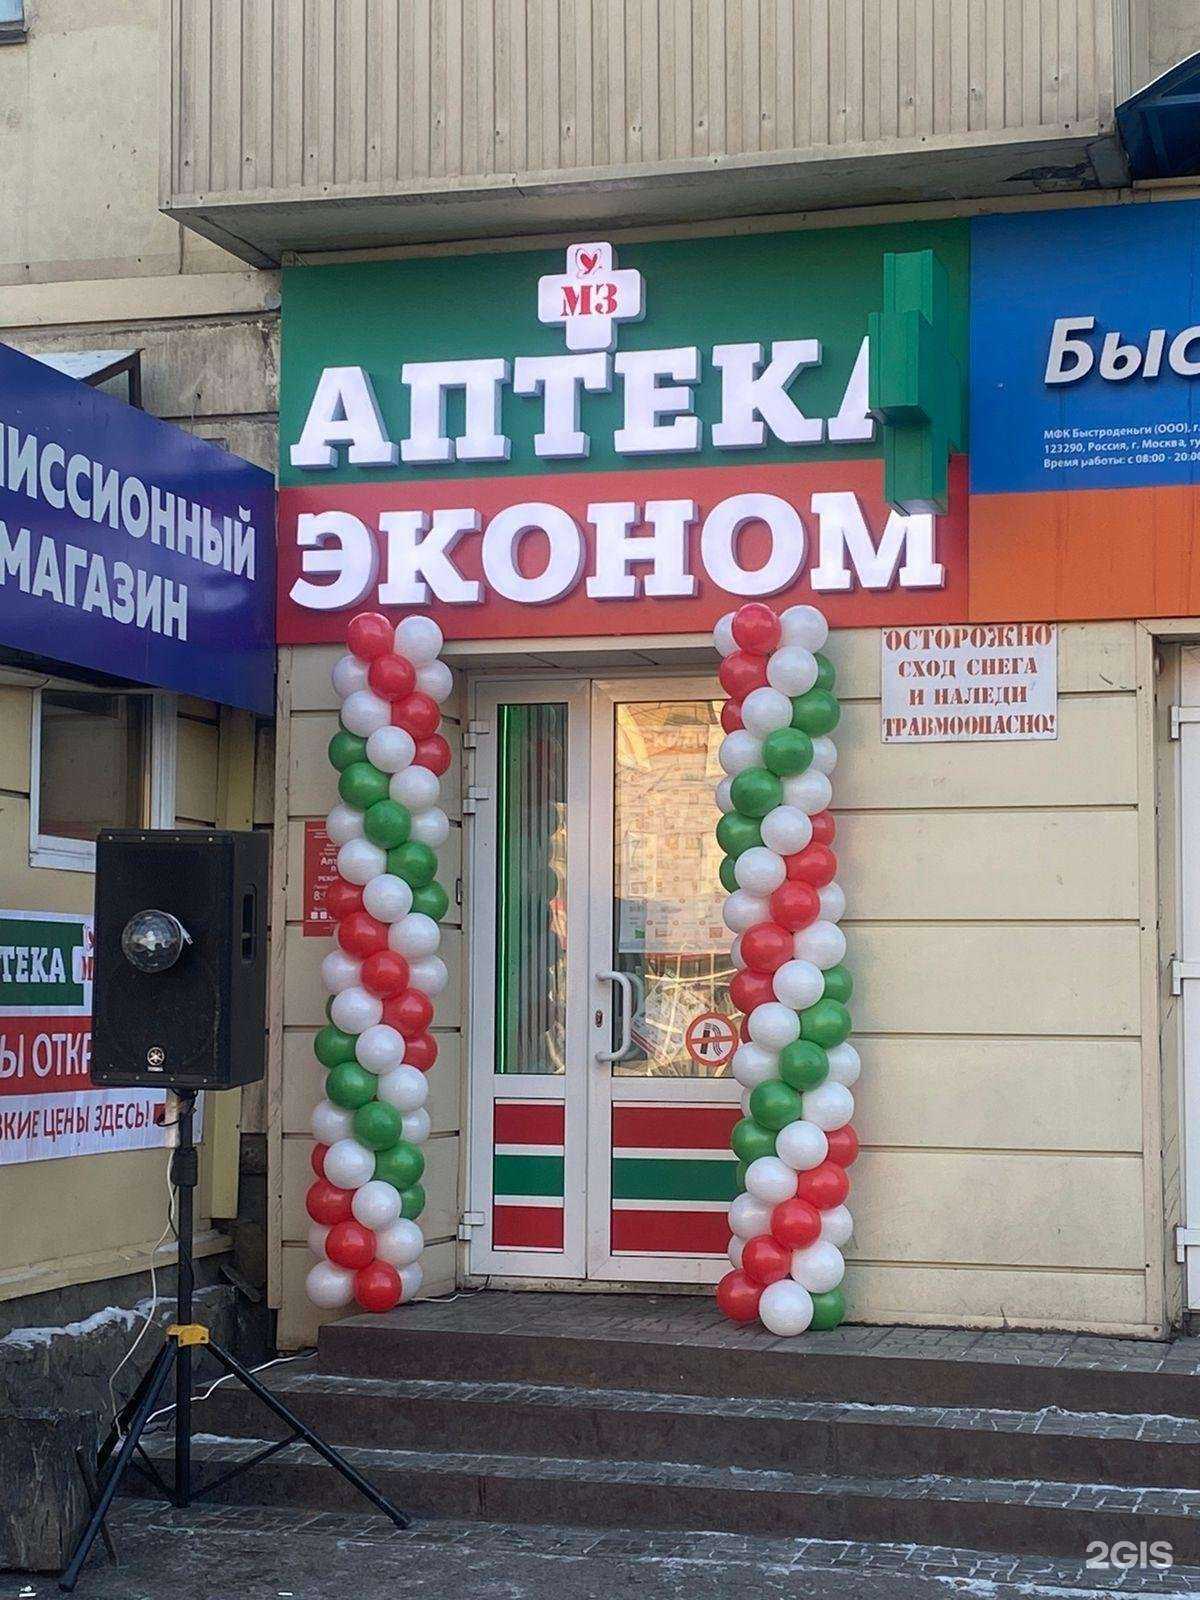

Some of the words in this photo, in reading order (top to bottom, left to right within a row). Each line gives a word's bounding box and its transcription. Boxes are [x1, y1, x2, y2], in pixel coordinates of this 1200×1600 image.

[1044, 429, 1070, 439] МФК
[1072, 426, 1152, 438] Быстроденьги
[1088, 441, 1130, 452] Россия,
[1141, 439, 1187, 449] Москва,
[1044, 459, 1079, 469] Время
[1081, 456, 1126, 468] работы:
[1135, 453, 1166, 464] 08:00
[0, 422, 256, 581] ИССИОННЫЙ
[289, 490, 946, 611] ЭКОНОМ
[0, 520, 189, 642] МАГАЗИН
[885, 624, 1053, 651] ОСТОРОЖНО
[898, 659, 956, 679] СХОД
[966, 656, 1038, 677] СНЕГА
[908, 688, 925, 706] И
[934, 685, 1027, 706] НАЛЕДИ
[883, 714, 1056, 737] ТРАВМООПАСНО!
[0, 946, 66, 983] ТЕКА
[0, 1110, 40, 1141] КИЕ
[43, 1105, 91, 1142] ЦЕНЫ
[94, 1100, 150, 1138] ЗДЕСЬ!
